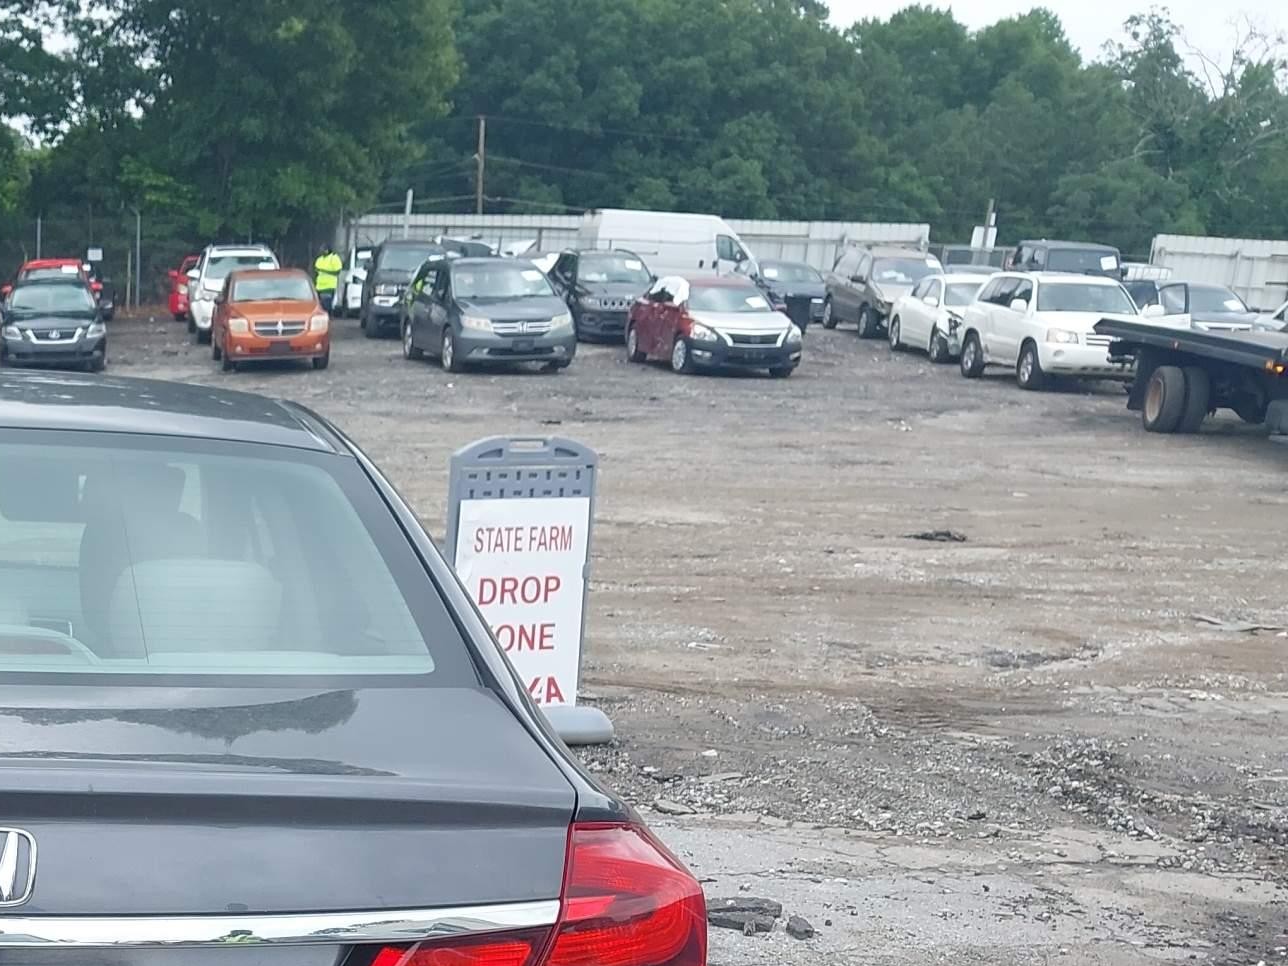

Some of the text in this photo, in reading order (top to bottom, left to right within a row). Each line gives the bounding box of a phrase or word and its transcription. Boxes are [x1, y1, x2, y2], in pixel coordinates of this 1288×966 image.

[474, 525, 574, 553] STATE FARM
[478, 576, 561, 605] DROP
[488, 623, 556, 651] ONE
